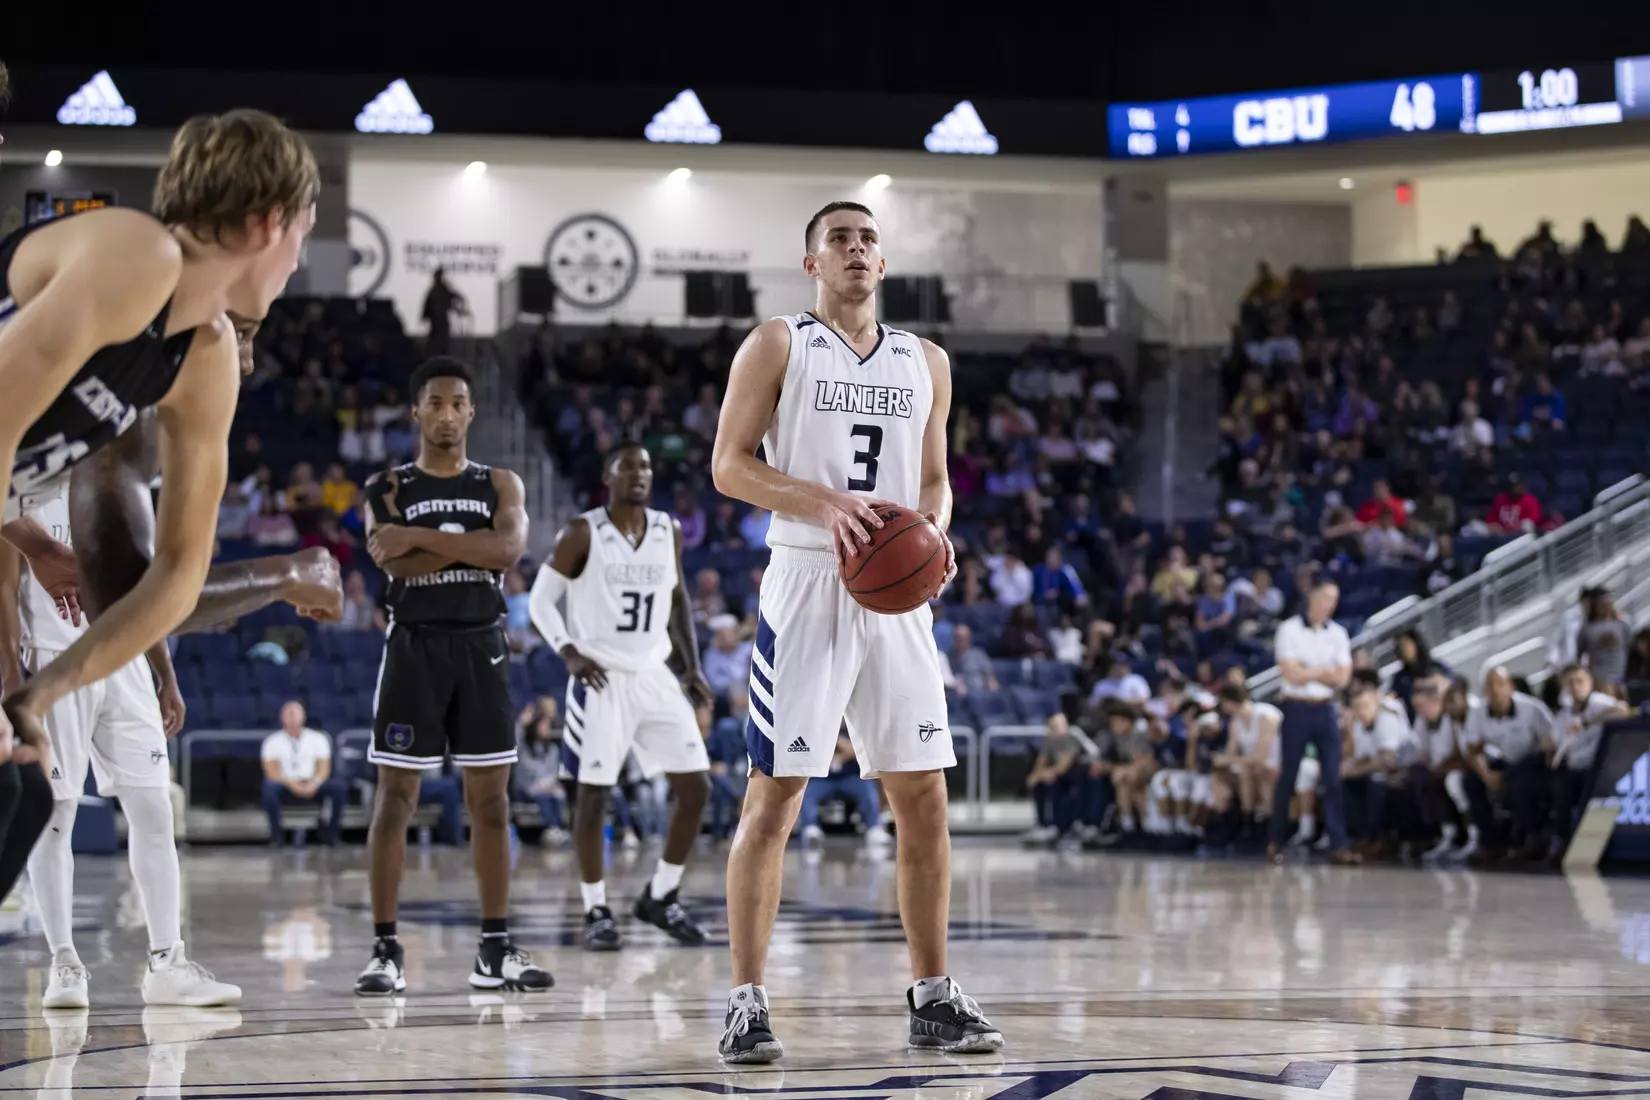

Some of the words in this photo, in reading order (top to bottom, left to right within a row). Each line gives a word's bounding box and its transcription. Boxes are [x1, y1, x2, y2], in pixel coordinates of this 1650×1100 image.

[1389, 81, 1437, 132] 48
[1517, 67, 1578, 110] 1:00
[1233, 93, 1329, 147] CBU
[810, 342, 831, 350] adidas
[891, 347, 912, 358] WAC
[815, 380, 914, 419] LANCERS
[848, 424, 884, 492] 3
[404, 498, 492, 522] CENTRAL
[616, 591, 656, 633] 31
